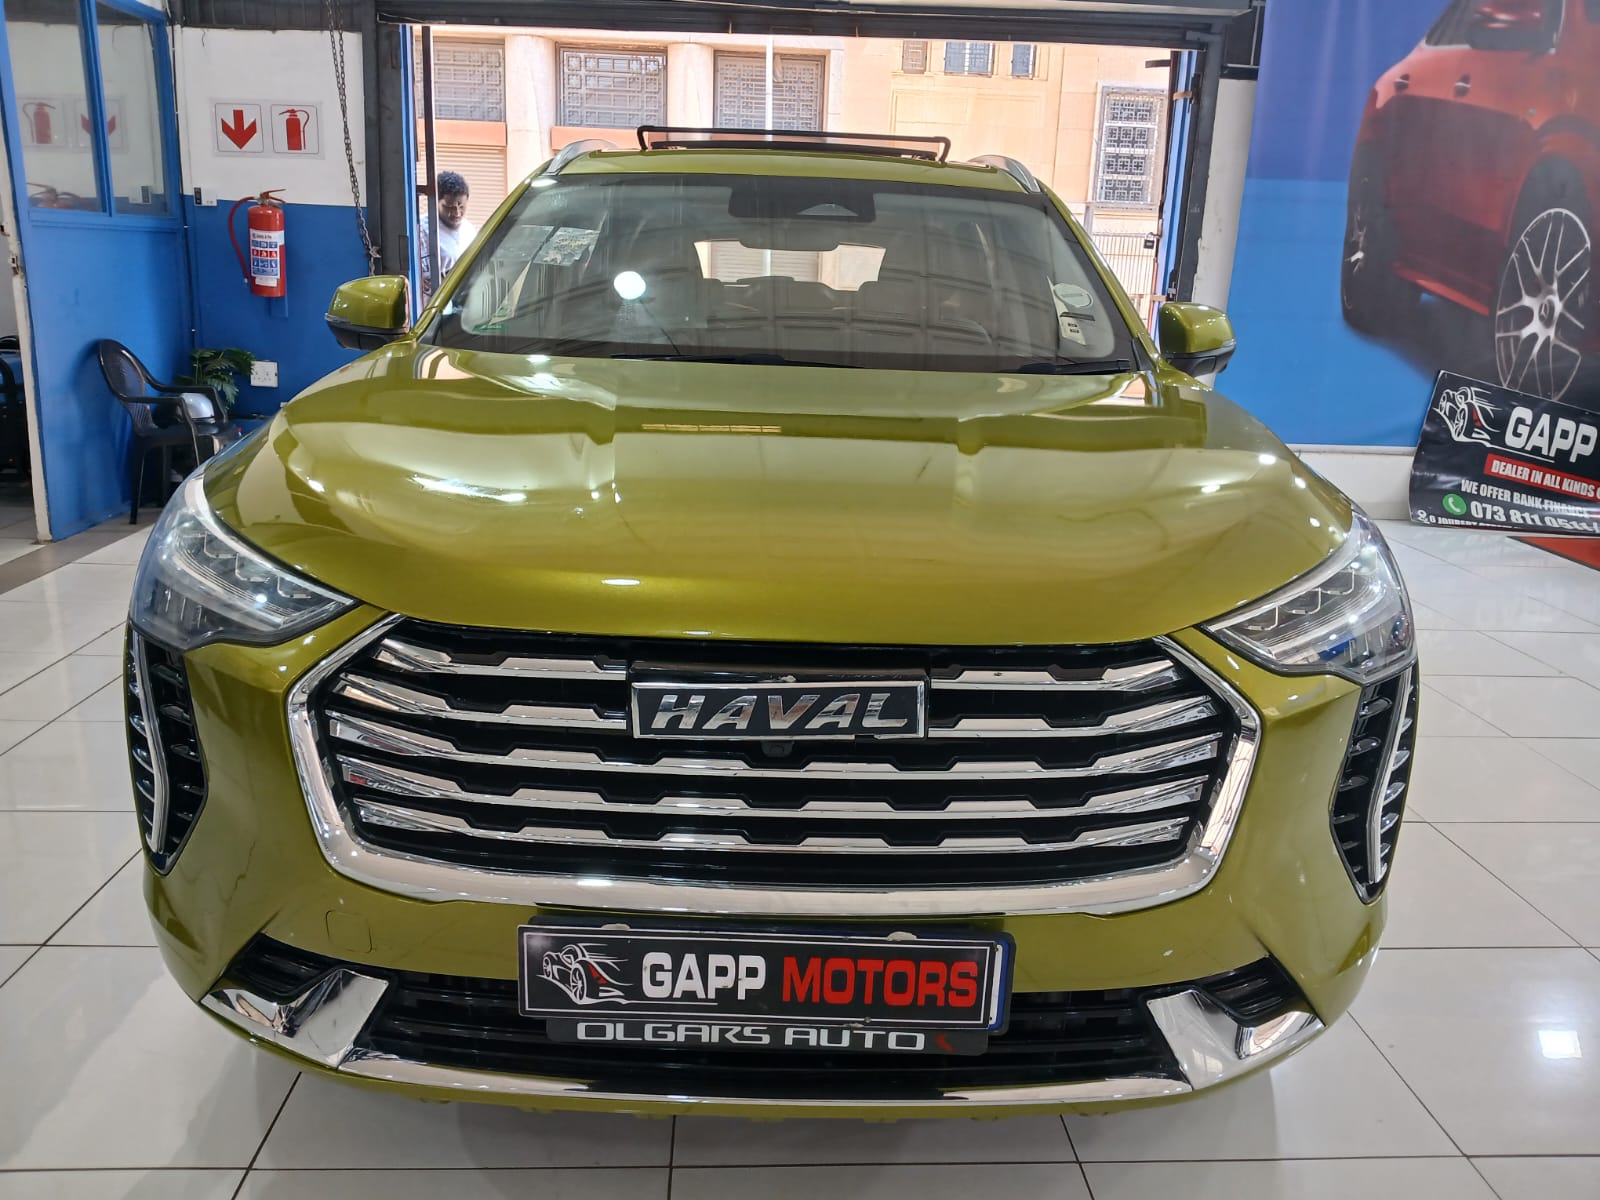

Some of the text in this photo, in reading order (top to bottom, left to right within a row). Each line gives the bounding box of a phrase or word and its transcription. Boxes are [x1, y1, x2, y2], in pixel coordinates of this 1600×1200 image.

[1504, 406, 1598, 463] GAPP
[1461, 479, 1479, 494] WE
[1480, 484, 1511, 502] OFFER
[1513, 492, 1542, 509] BANK
[1491, 460, 1530, 481] DEALER
[1530, 470, 1543, 484] IN
[1543, 473, 1561, 489] ALL
[1562, 478, 1596, 498] KINDS
[1470, 500, 1507, 522] 073
[1509, 509, 1543, 526] 811
[651, 693, 908, 730] HAVAL
[641, 952, 979, 1008] GAPP MOTORS
[576, 1022, 926, 1051] OLGARS AUTO
